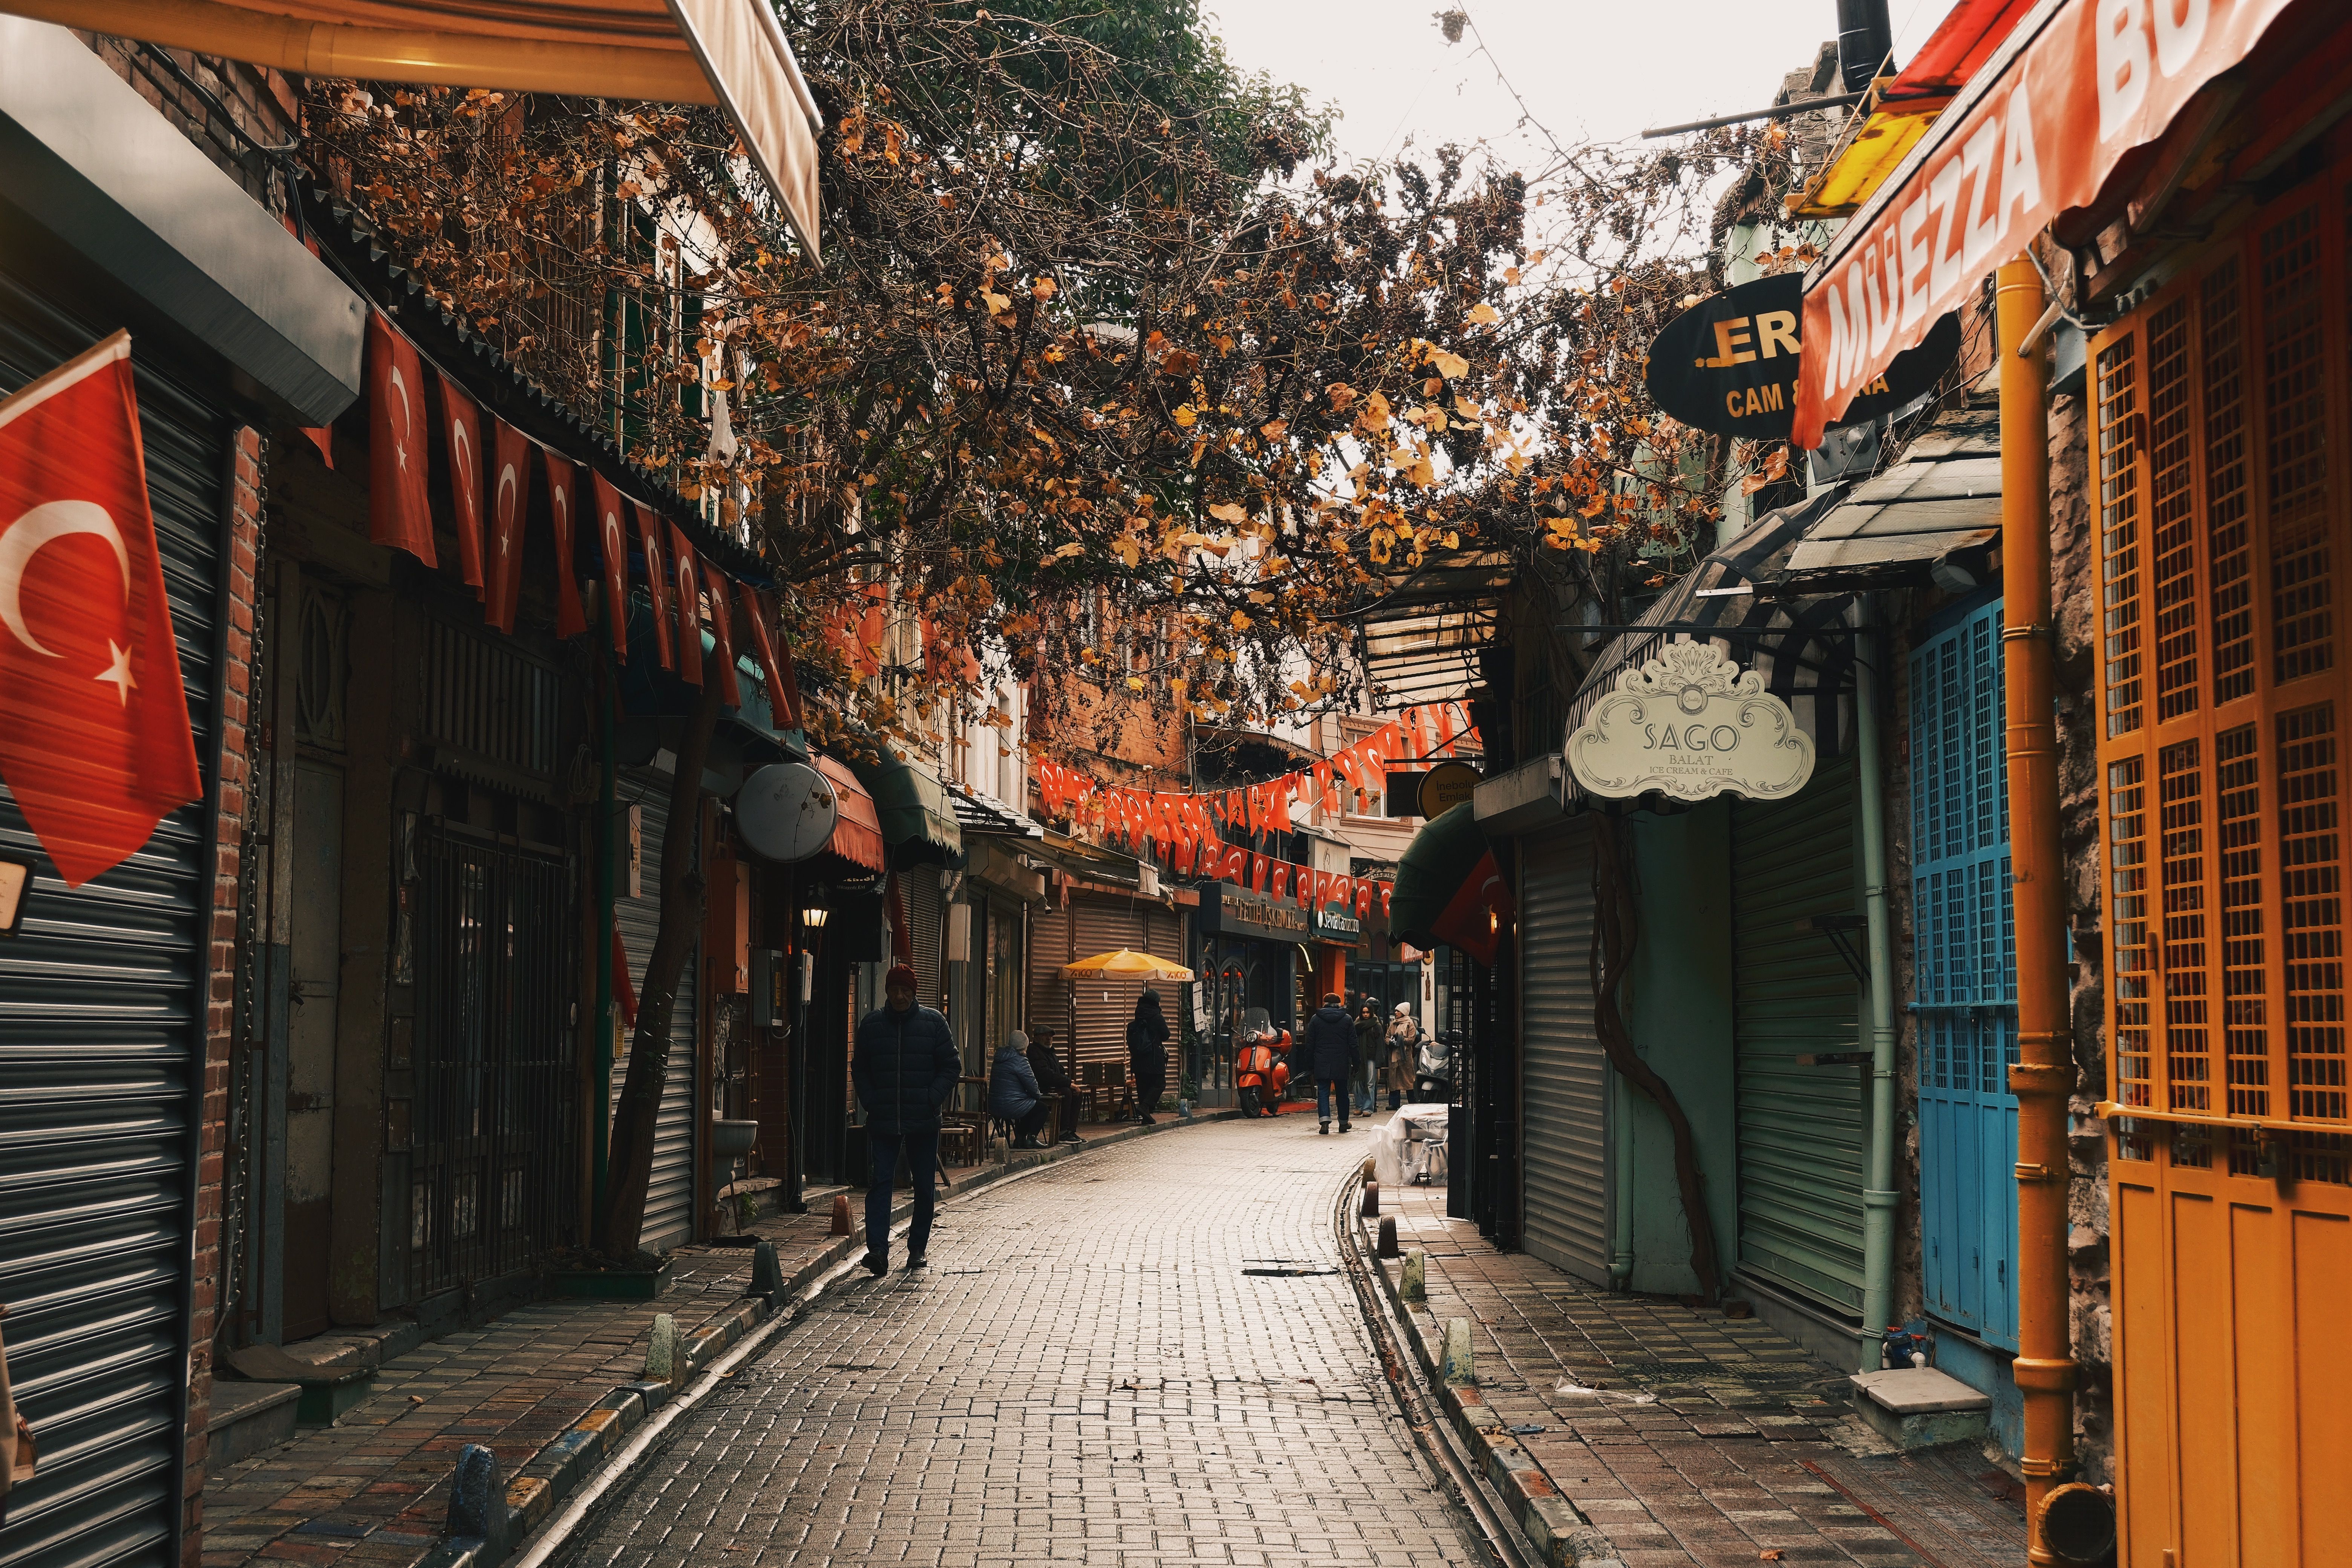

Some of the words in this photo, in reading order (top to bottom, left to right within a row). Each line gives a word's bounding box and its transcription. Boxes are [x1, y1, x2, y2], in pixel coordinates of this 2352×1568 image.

[1824, 81, 2040, 401] MÜEZZA
[1726, 383, 1784, 418] CAM
[1643, 723, 1740, 752] SAGO
[1669, 755, 1713, 765] BALAT
[1436, 779, 1474, 791] İnebolu
[1439, 792, 1470, 802] Emlak
[1325, 911, 1338, 929] Sevda
[1338, 914, 1359, 933] Gazozcusu
